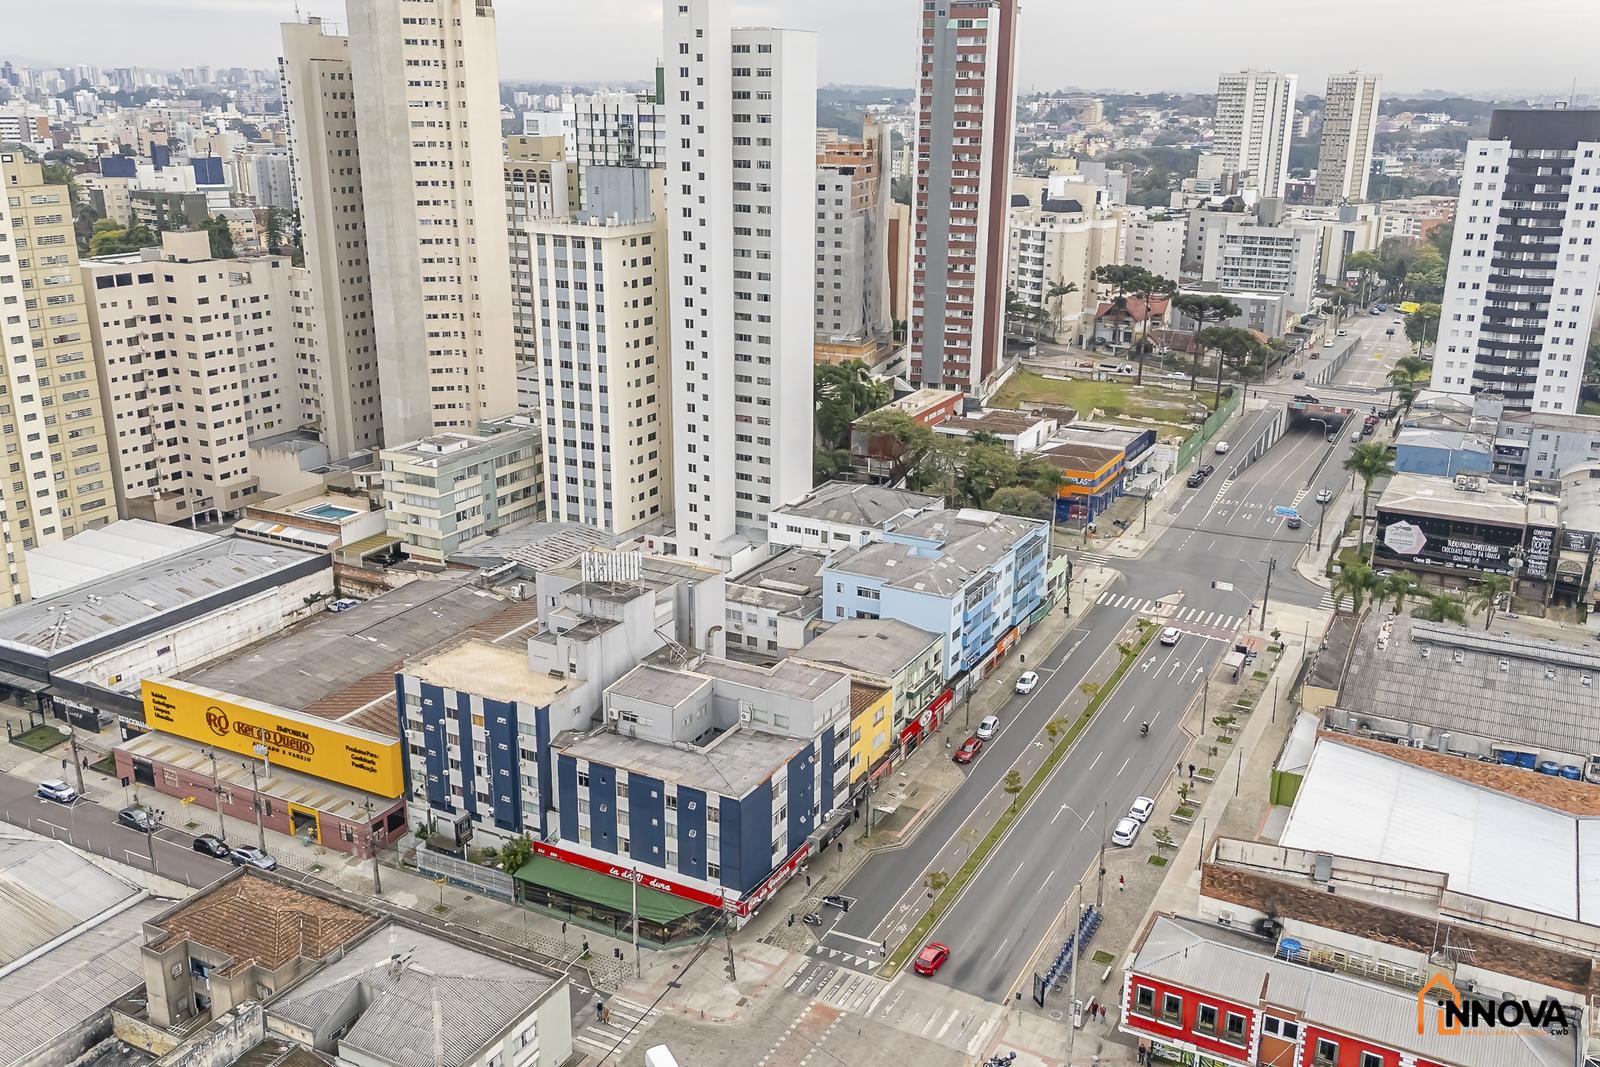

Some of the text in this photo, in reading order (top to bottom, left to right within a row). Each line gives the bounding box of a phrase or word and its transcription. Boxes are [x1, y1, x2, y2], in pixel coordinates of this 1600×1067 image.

[206, 711, 229, 734] RQ
[237, 721, 310, 753] Rei do Queijo
[288, 752, 312, 762] VAREJO
